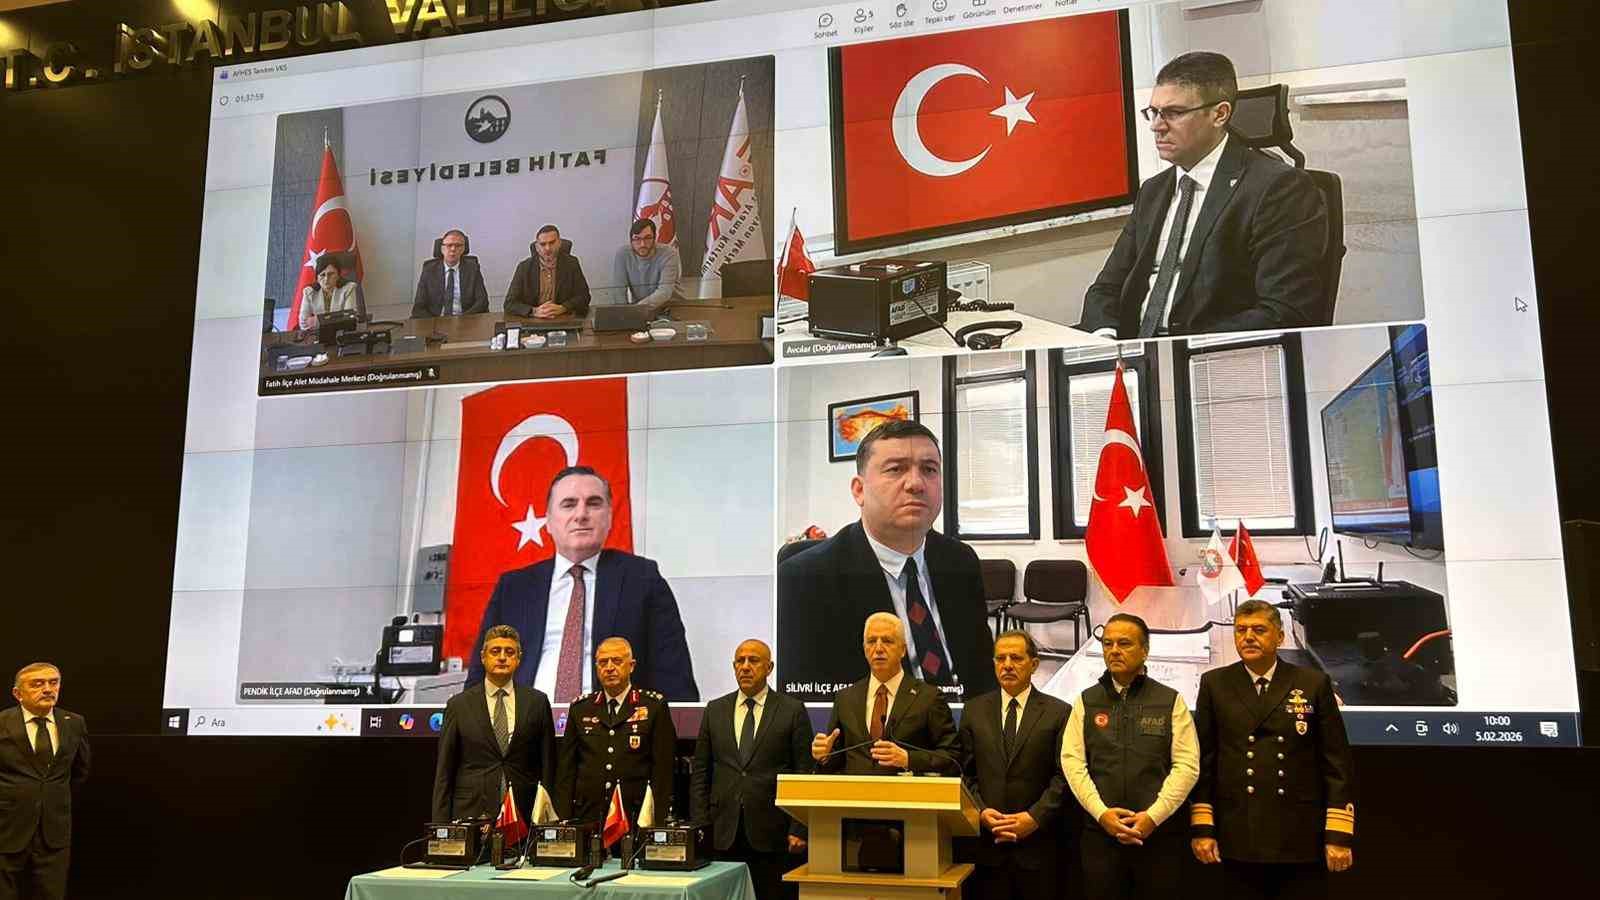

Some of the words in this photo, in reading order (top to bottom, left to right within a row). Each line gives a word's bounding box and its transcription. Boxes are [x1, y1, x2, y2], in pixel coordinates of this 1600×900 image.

[814, 30, 838, 39] Sohbet
[925, 15, 942, 24] Tepki
[962, 8, 996, 19] Görünüm
[1003, 3, 1042, 14] Denetimler
[114, 1, 362, 73] İSTANBUL
[786, 343, 811, 354] Avcılar
[812, 340, 877, 354] (Doğrulanmamış)
[265, 380, 280, 388] Fatih
[293, 378, 307, 386] Afet
[308, 376, 340, 385] Müdahale
[341, 374, 366, 383] Merkezi
[367, 370, 422, 382] (Doğrulanmamış)
[243, 687, 268, 696] PENDİK
[269, 686, 283, 698] İLÇE
[284, 687, 302, 696] AFAD
[303, 687, 361, 698] (Doğrulanmamış)
[815, 681, 831, 695] İLÇE
[211, 717, 226, 728] Ara
[1483, 715, 1511, 726] 10:00
[1475, 731, 1523, 742] 5.02.2026
